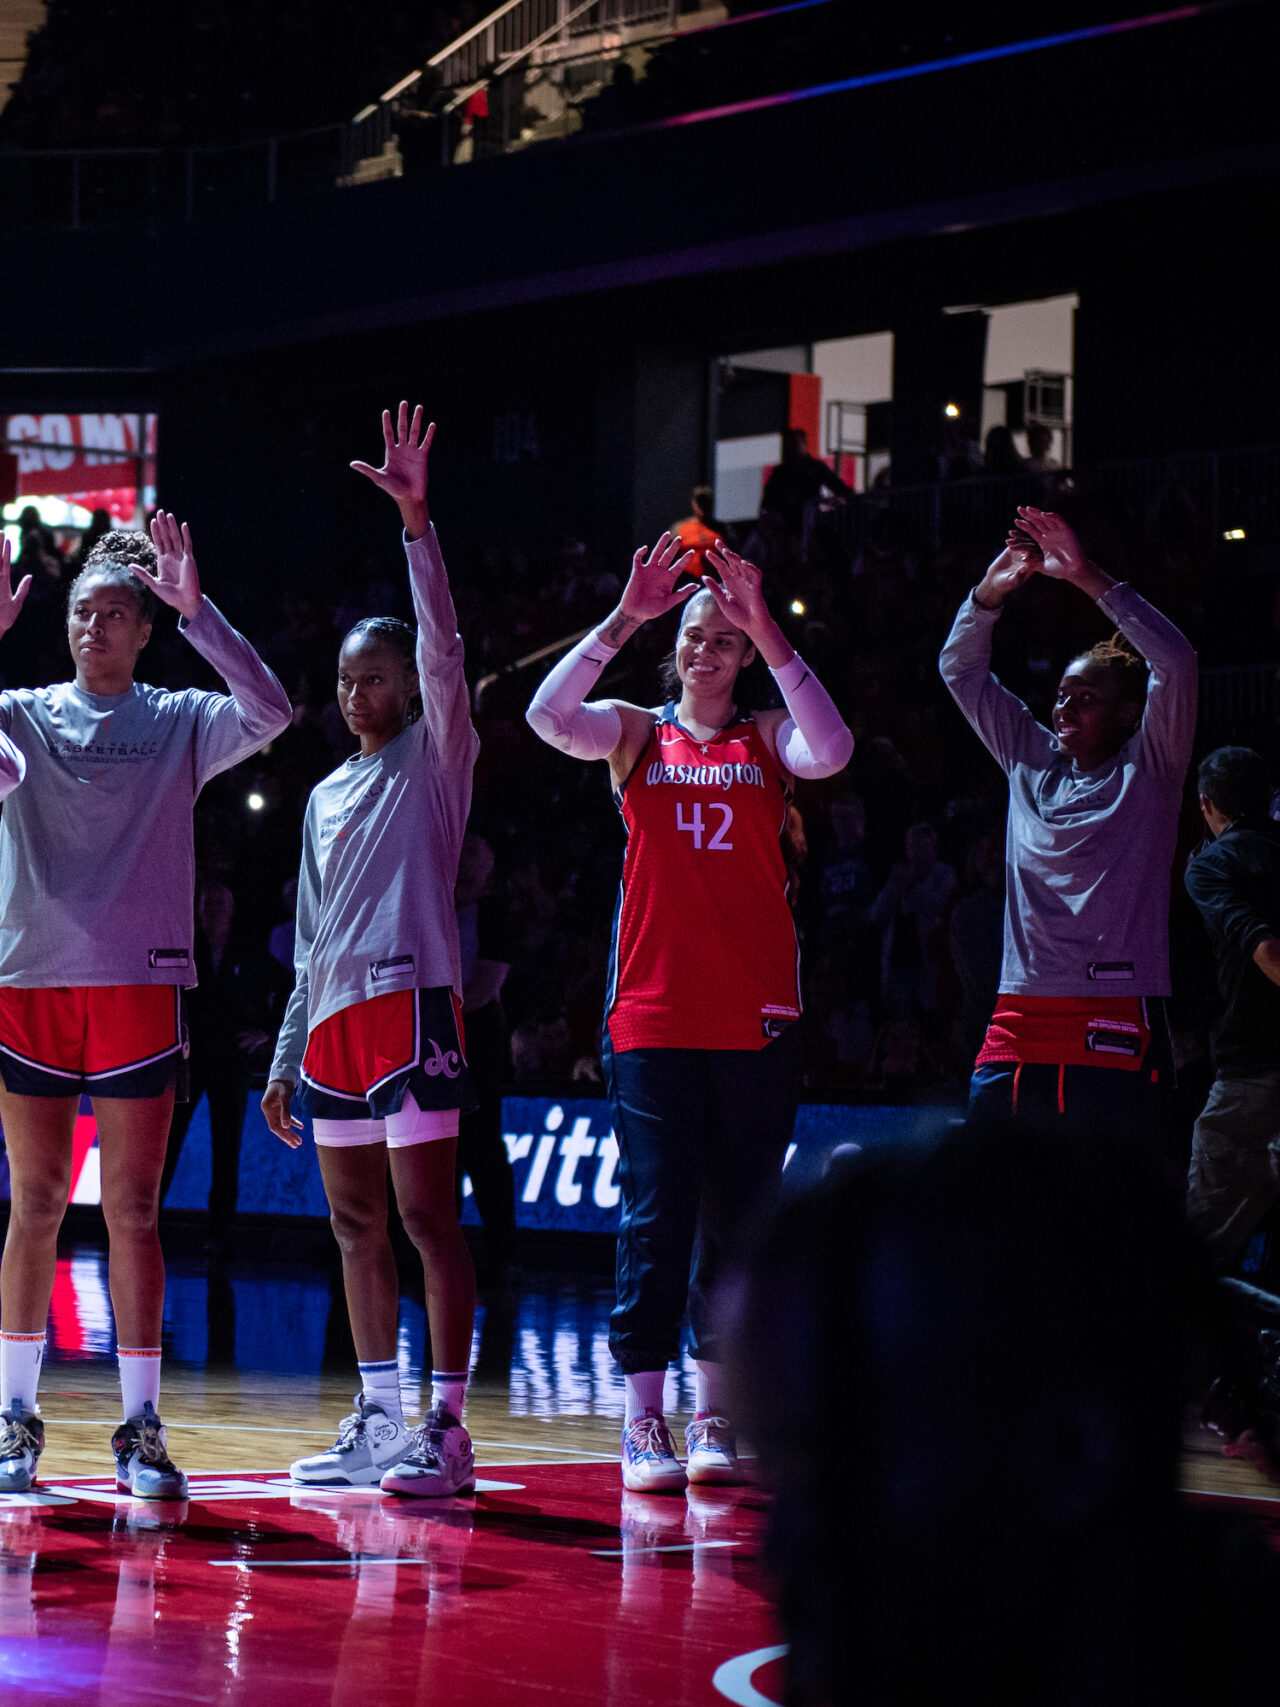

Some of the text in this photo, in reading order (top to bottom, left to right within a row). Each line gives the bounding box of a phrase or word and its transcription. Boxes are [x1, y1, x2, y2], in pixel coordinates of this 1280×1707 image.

[7, 413, 75, 474] GO
[49, 743, 158, 757] BASKETBALL
[676, 801, 734, 851] 42
